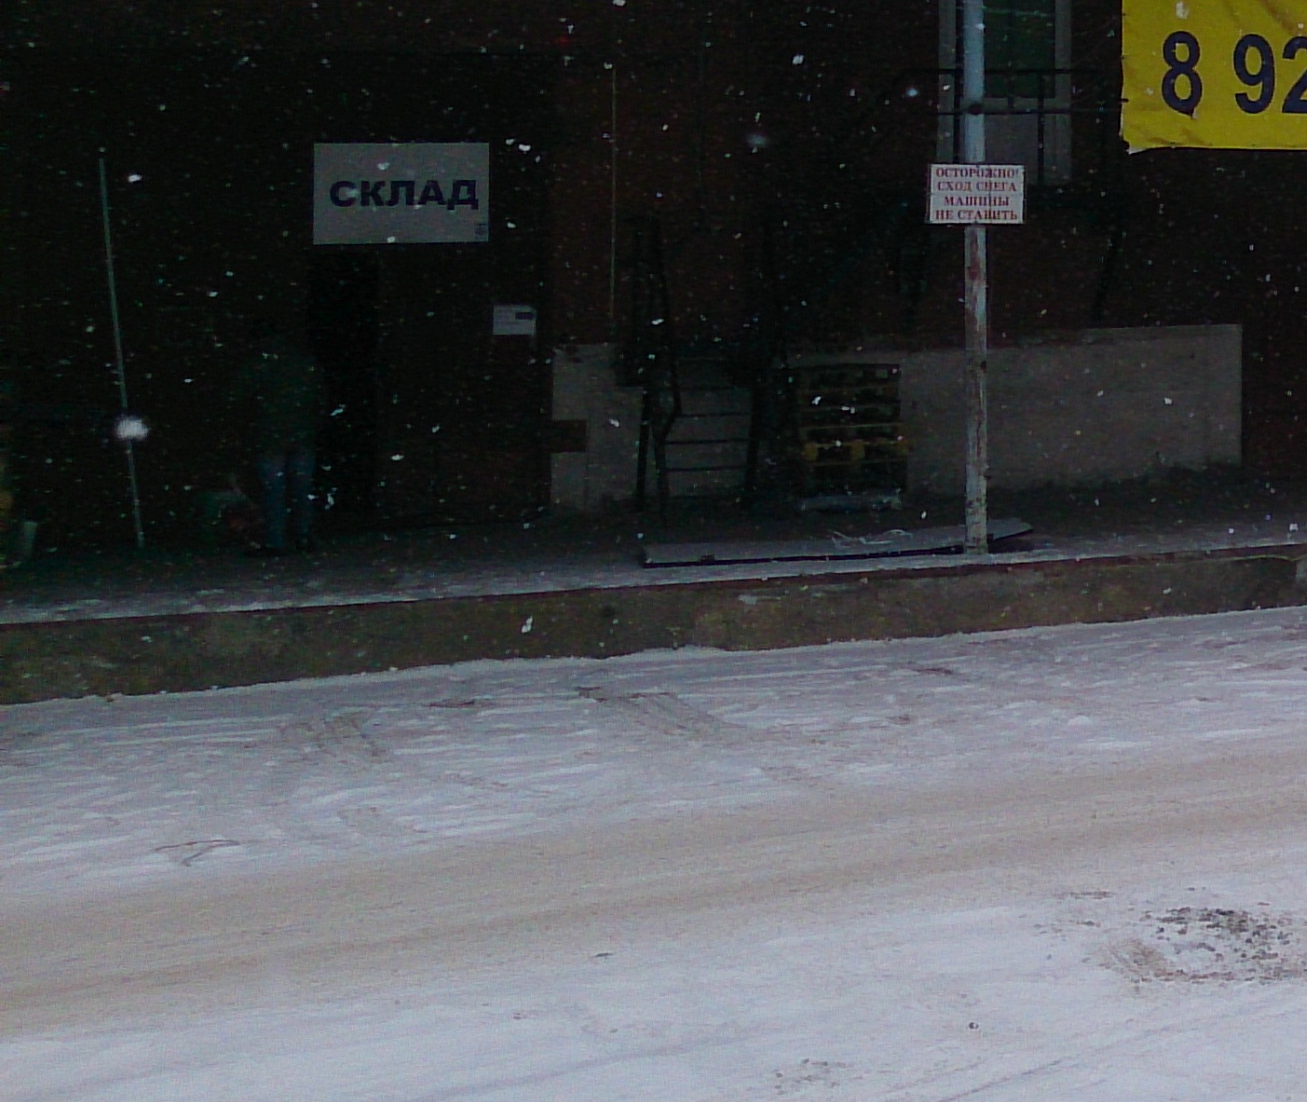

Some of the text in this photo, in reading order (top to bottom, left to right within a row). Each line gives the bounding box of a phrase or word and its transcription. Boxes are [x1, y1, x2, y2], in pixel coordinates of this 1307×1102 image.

[1161, 30, 1203, 116] 8
[330, 179, 478, 210] СКЛАД
[937, 181, 1017, 192] СХОД СНЕГА
[943, 196, 1009, 207] МАШИНЫ
